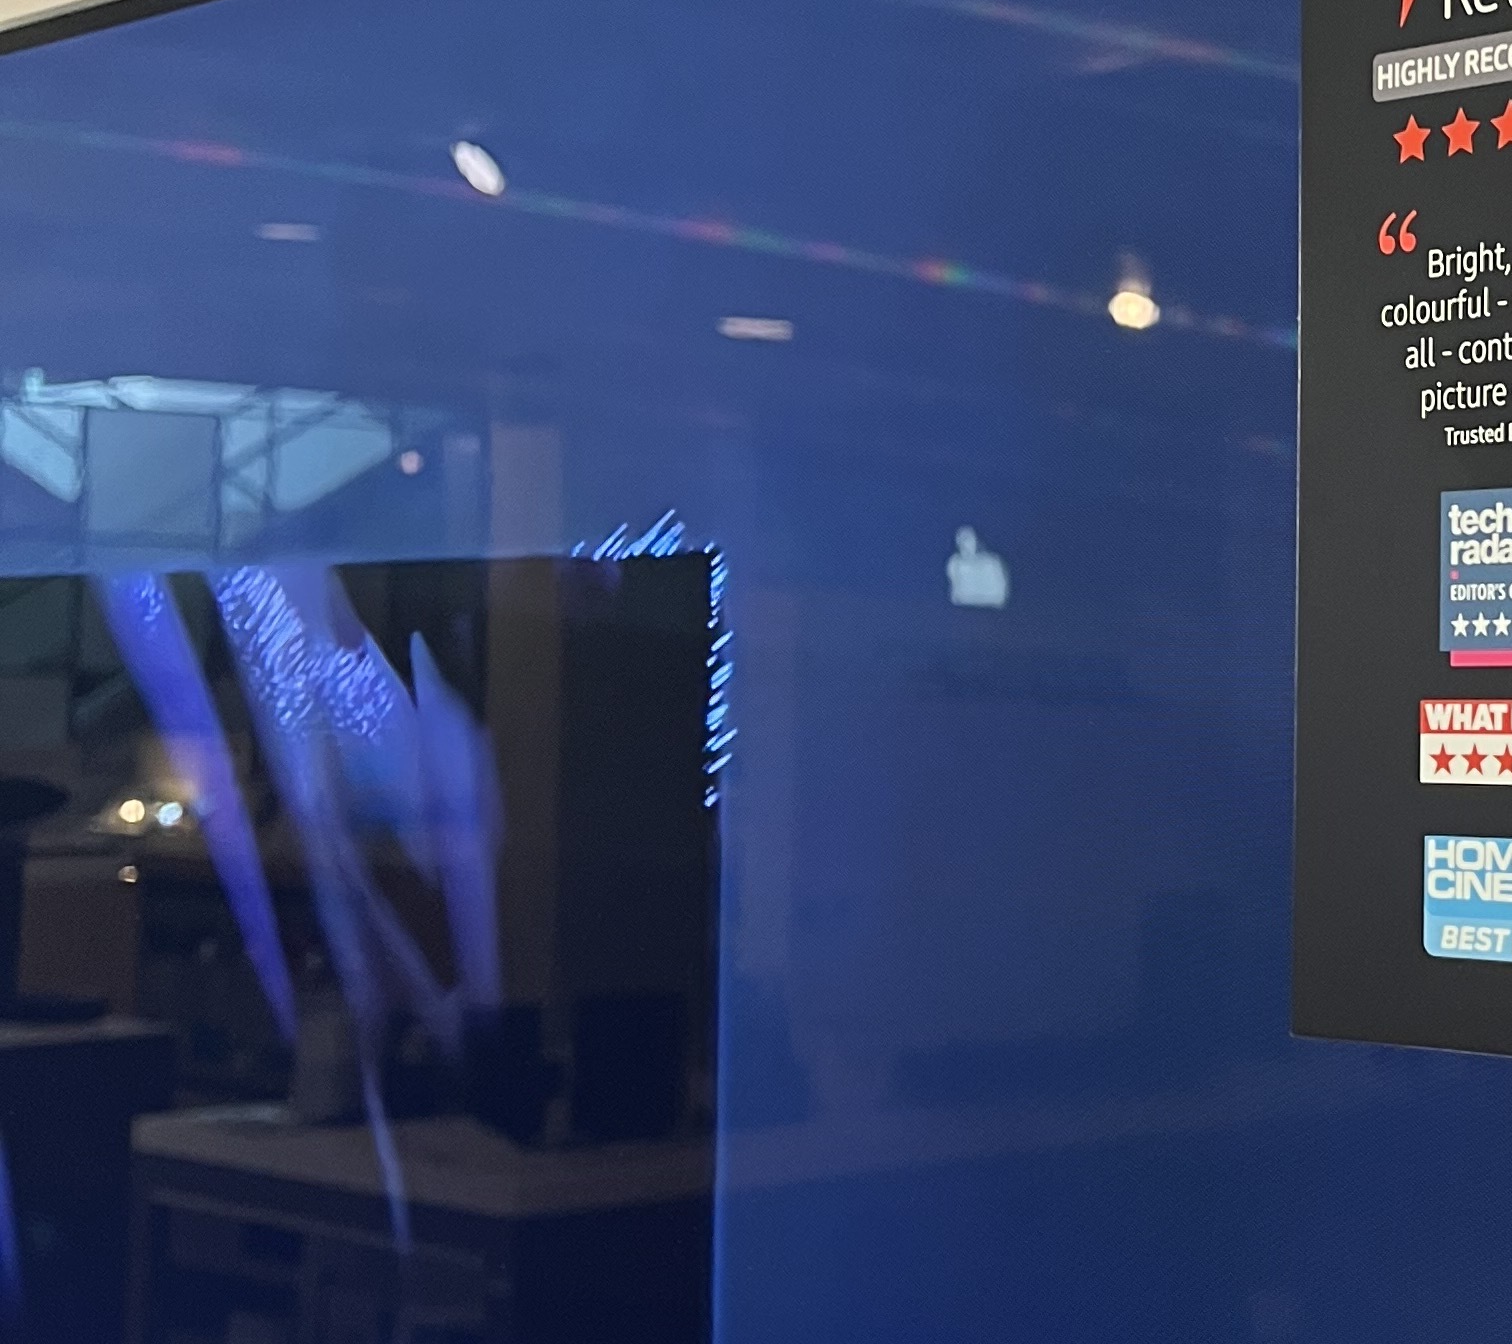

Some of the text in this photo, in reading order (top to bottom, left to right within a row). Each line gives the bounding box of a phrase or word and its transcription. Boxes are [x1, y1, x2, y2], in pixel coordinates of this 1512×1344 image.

[1376, 51, 1460, 91] HIGHLY
[1427, 241, 1511, 283] Bright,
[1380, 286, 1491, 328] colourful
[1405, 336, 1436, 369] all
[1420, 380, 1507, 419] picture
[1444, 422, 1505, 446] Trusted
[1450, 583, 1506, 601] EDITOR'S
[1424, 703, 1508, 731] WHAT
[1440, 925, 1511, 953] BEST
